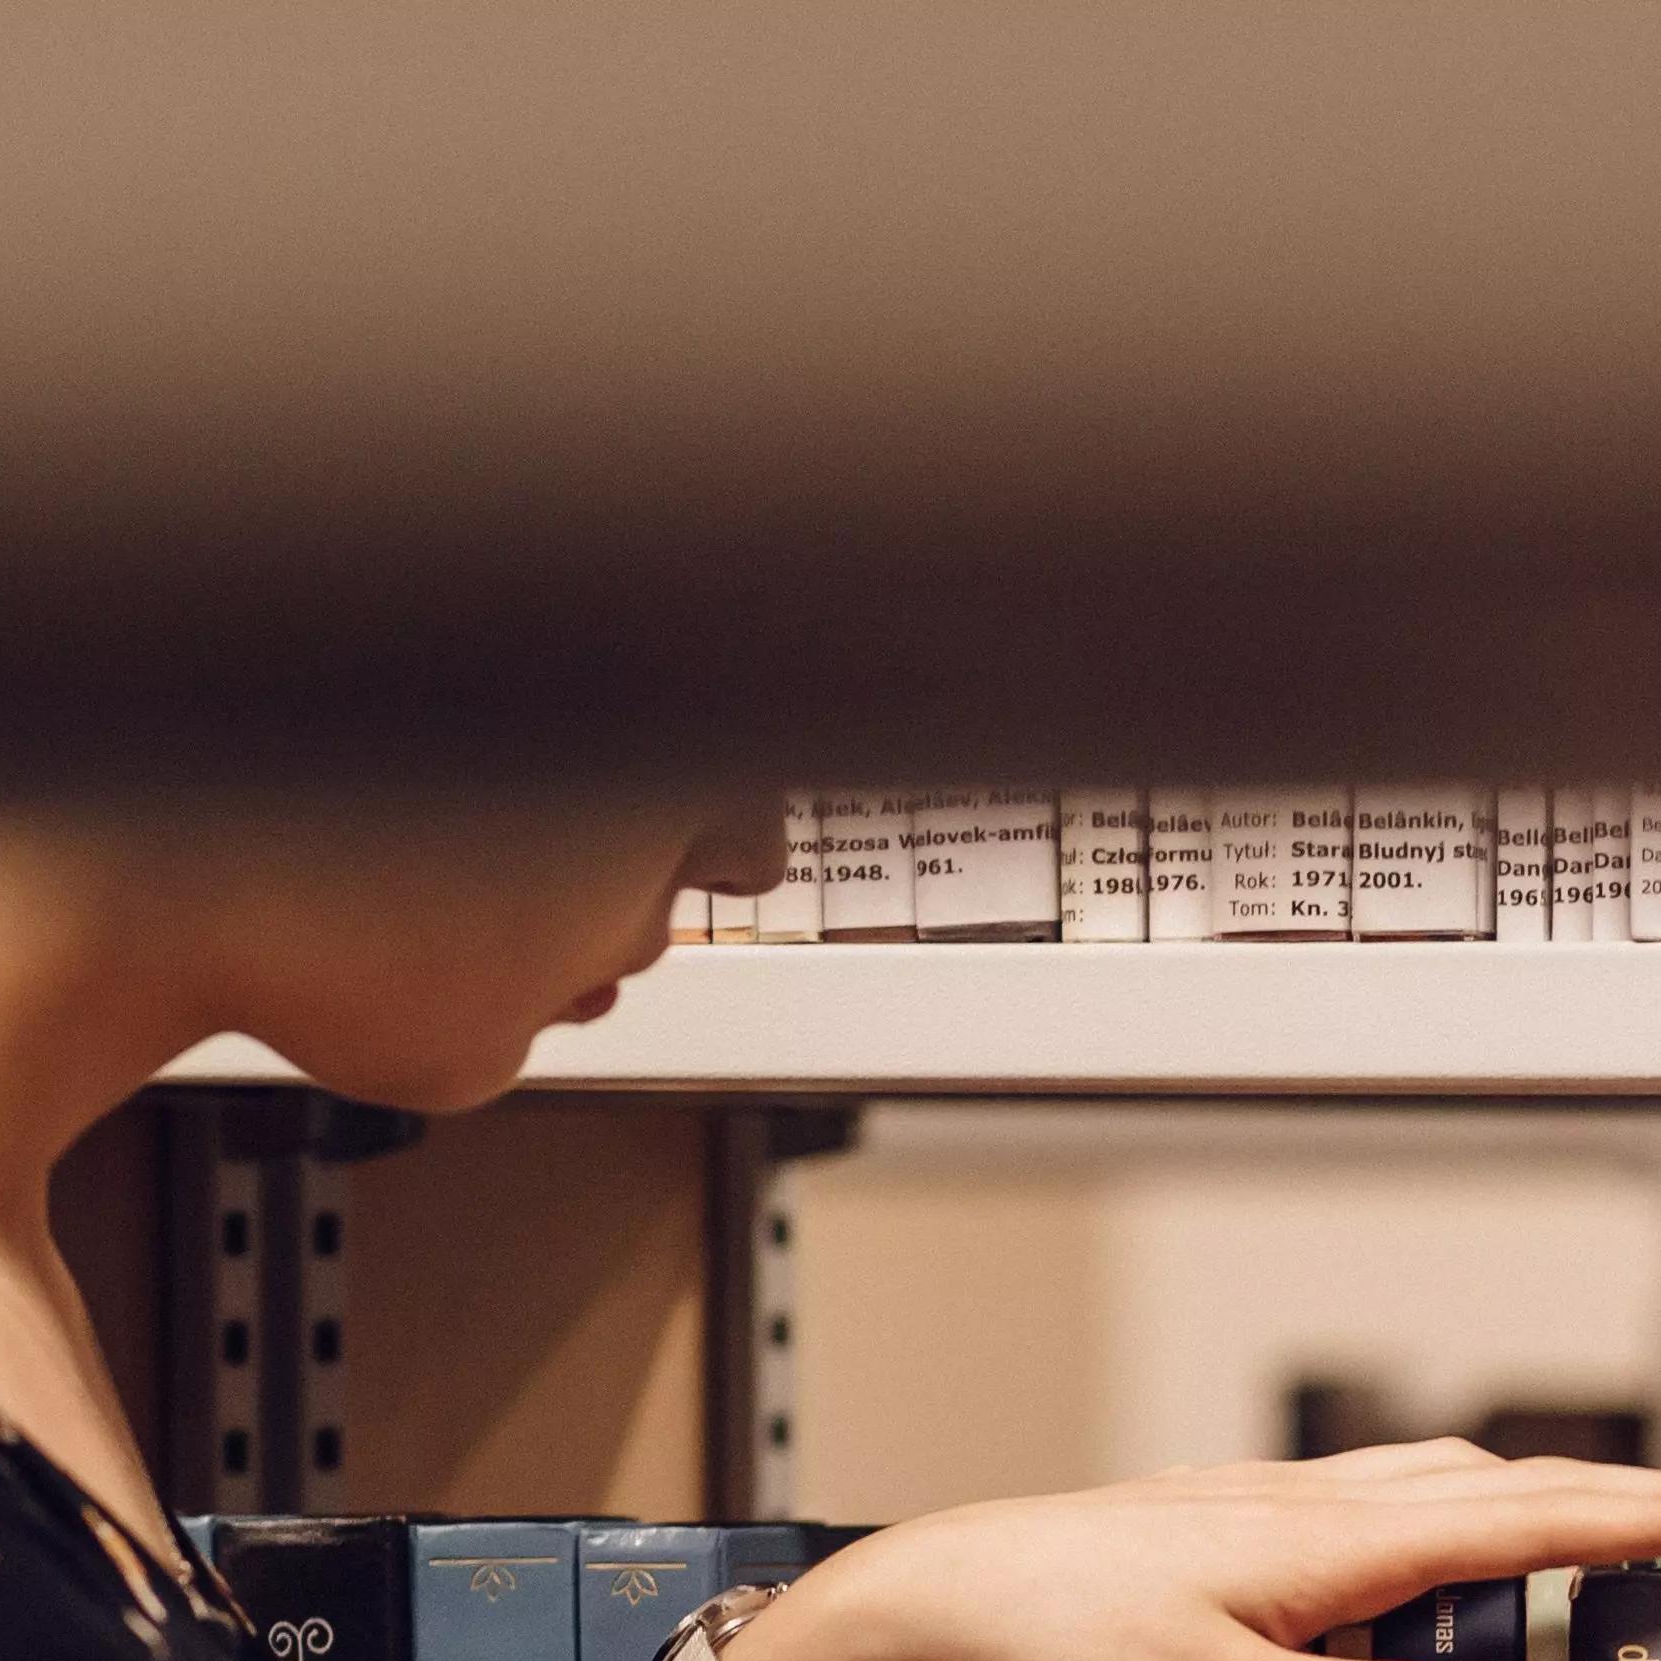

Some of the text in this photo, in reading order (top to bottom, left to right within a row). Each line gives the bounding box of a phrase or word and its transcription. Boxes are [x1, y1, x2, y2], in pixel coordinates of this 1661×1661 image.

[1358, 842, 1445, 863] Bludnyj
[1234, 871, 1277, 890] Rok:
[1359, 871, 1423, 888] 2001.
[1229, 899, 1328, 917] Tom: Kn.
